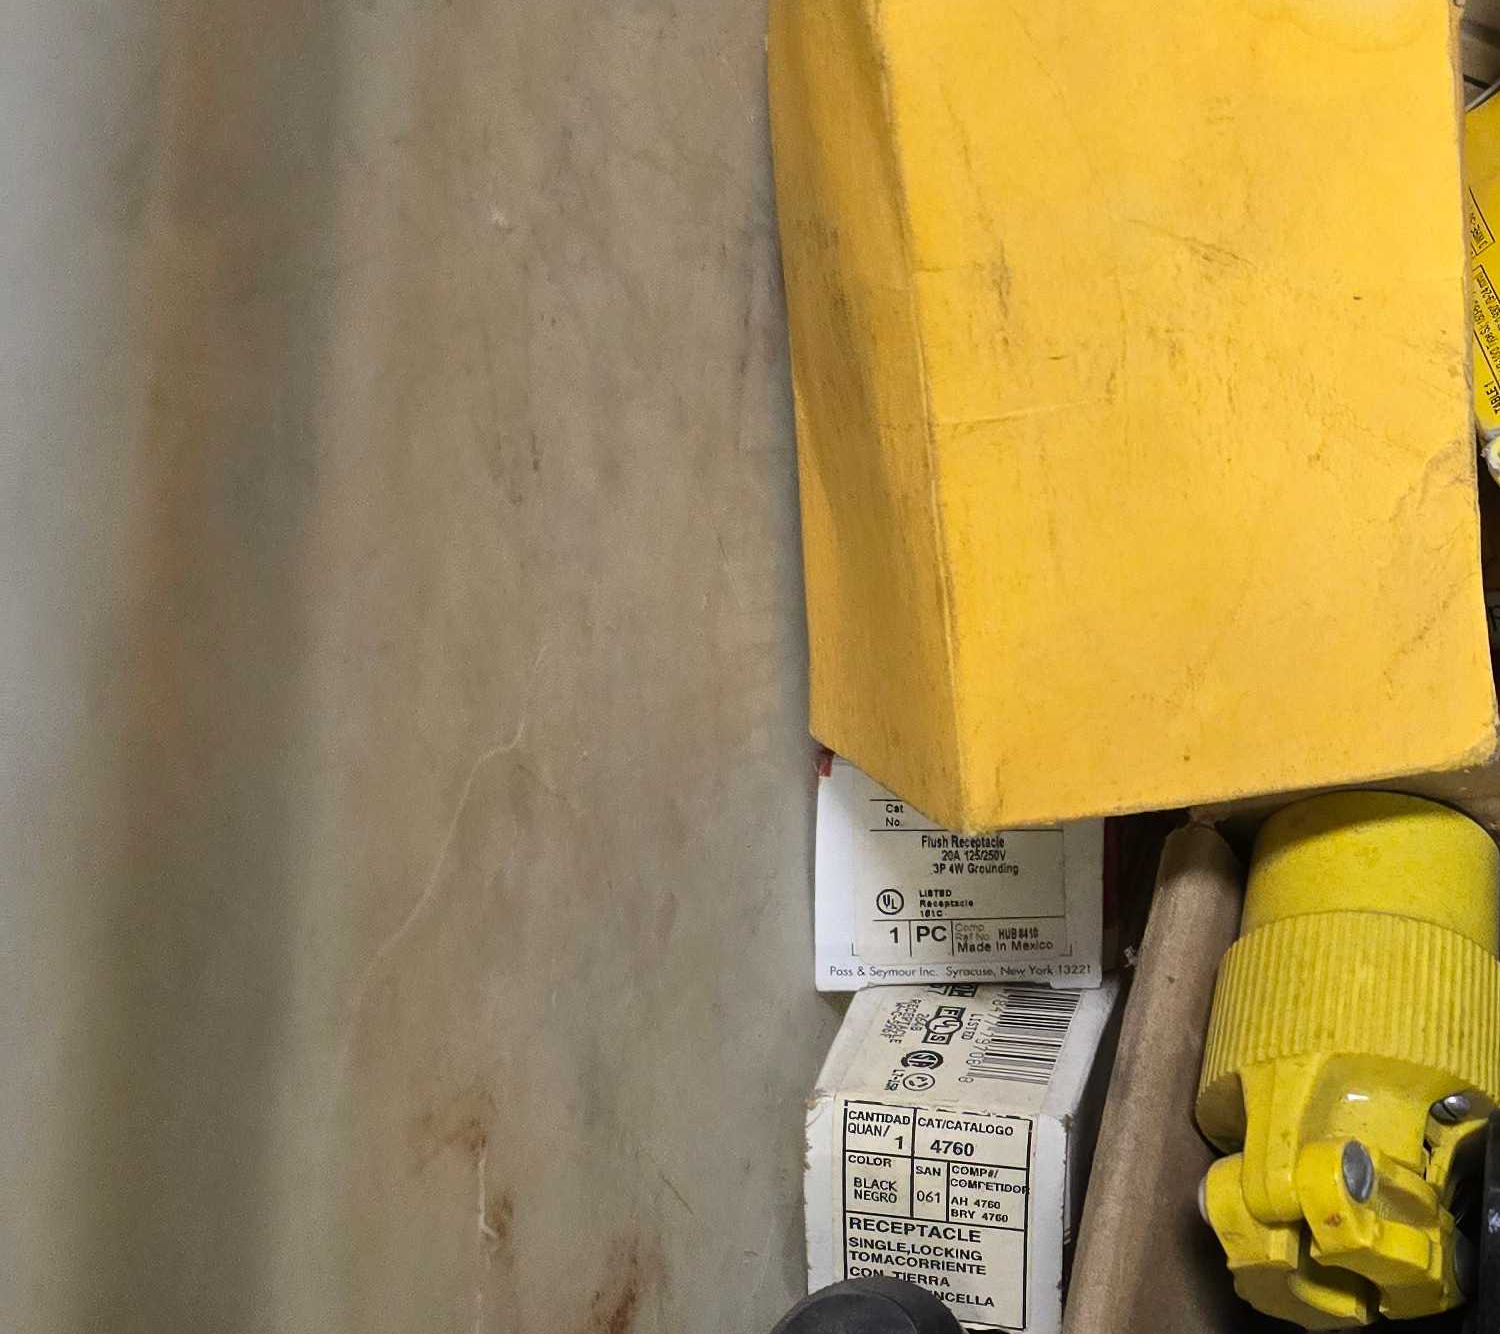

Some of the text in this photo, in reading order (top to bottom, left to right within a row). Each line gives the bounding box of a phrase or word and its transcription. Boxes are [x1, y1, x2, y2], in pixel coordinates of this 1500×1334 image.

[885, 803, 904, 813] Cat
[921, 835, 1005, 853] Flush Receptacle
[941, 850, 1006, 862] 20A 125/250V
[967, 863, 1019, 876] Grounding
[889, 927, 899, 944] 1
[916, 926, 947, 943] PC
[957, 940, 992, 953] Made
[1011, 940, 1054, 951] Mexico
[857, 966, 866, 976] &
[868, 966, 916, 978] Seymour
[919, 966, 938, 976] Inc.
[945, 966, 997, 979] Syracuse,
[1000, 965, 1026, 976] New
[1028, 964, 1053, 976] York
[1058, 964, 1091, 975] 13221
[848, 1110, 911, 1126] CANTIDAD
[917, 1117, 1014, 1137] CAT/CATALOGO
[894, 1135, 904, 1150] 1
[930, 1139, 975, 1157] 4760
[848, 1155, 892, 1168] COLOR
[915, 1165, 942, 1177] SAN
[853, 1177, 898, 1192] BLACK
[853, 1190, 898, 1204] NEGRO
[916, 1190, 941, 1204] 061
[951, 1196, 1001, 1210] AH 4760
[950, 1208, 976, 1220] BRY
[848, 1217, 982, 1244] RECEPTACLE
[848, 1250, 987, 1276] TOMACORRIENTE
